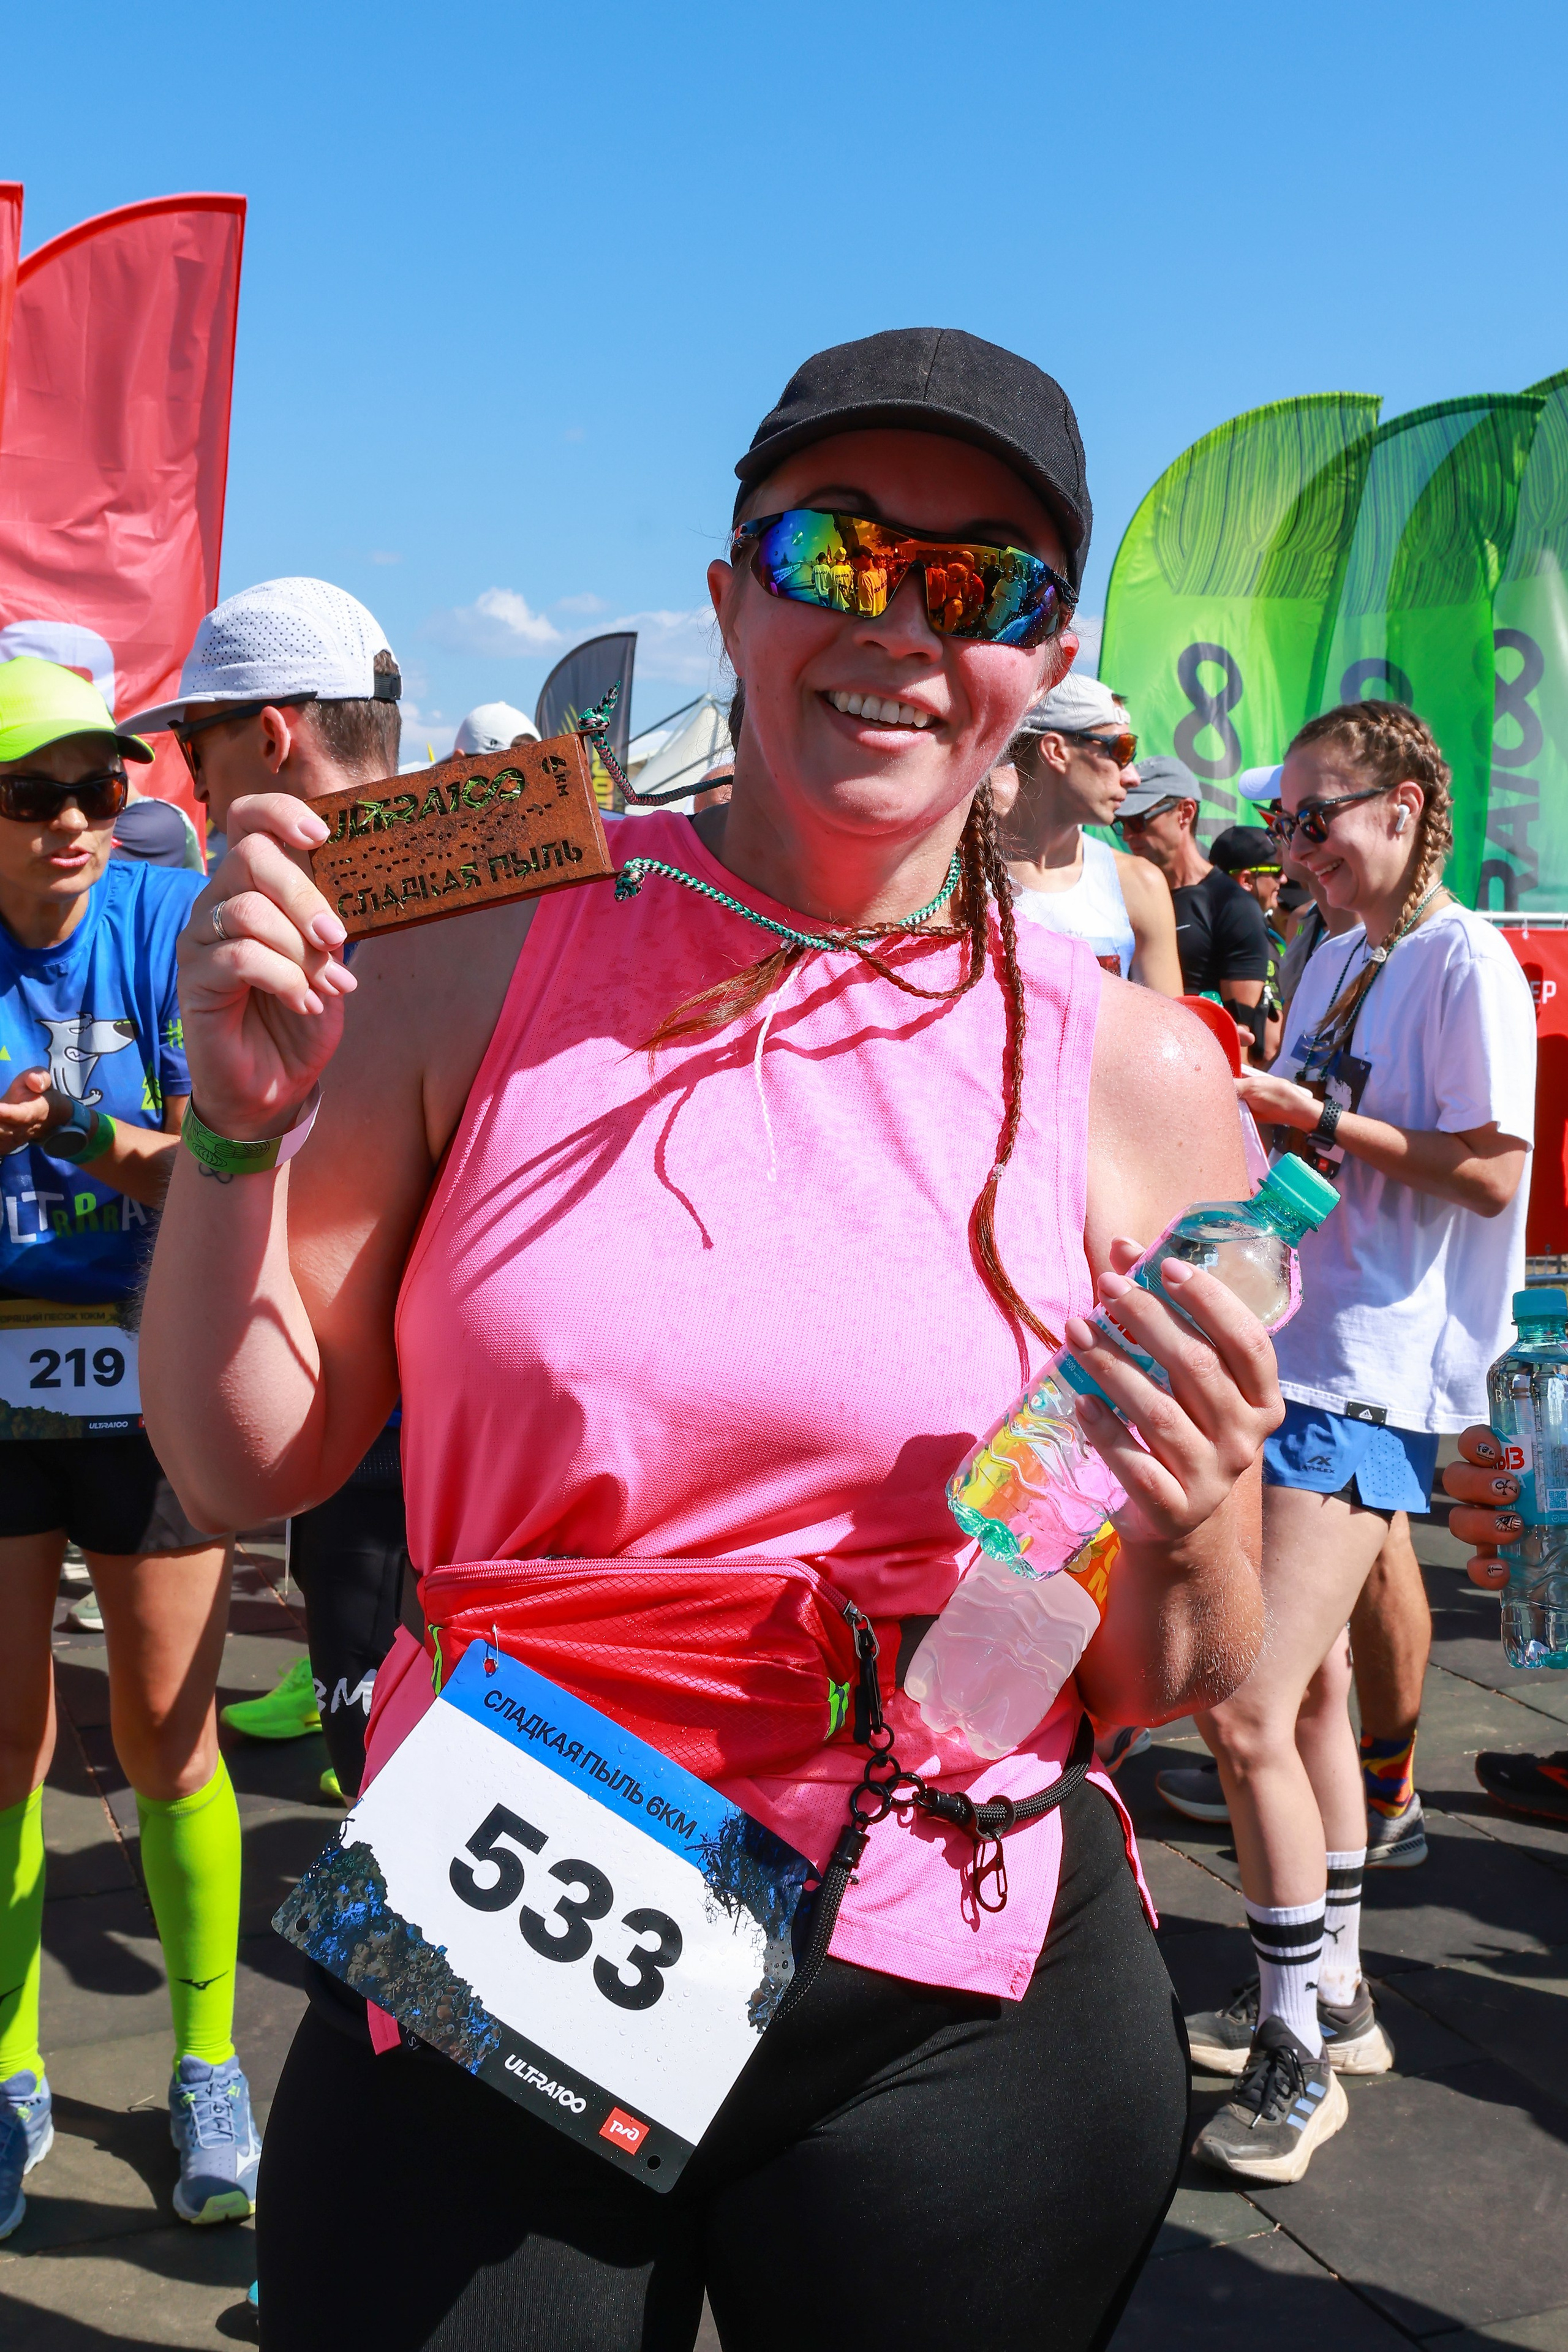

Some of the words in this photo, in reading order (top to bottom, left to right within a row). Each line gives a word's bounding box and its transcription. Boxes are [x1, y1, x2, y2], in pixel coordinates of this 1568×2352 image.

[337, 862, 481, 918] СЛАДКАЯ
[489, 839, 582, 883] ПЫЛЬ
[29, 1348, 125, 1389] 219
[89, 1420, 129, 1430] ULTRA100
[484, 1689, 587, 1768] СЛАДКАЯ
[578, 1749, 642, 1805] ПЫЛЬ
[645, 1794, 698, 1841] 6КМ
[449, 1802, 683, 2011] 533
[503, 2052, 588, 2114] ULTRA100
